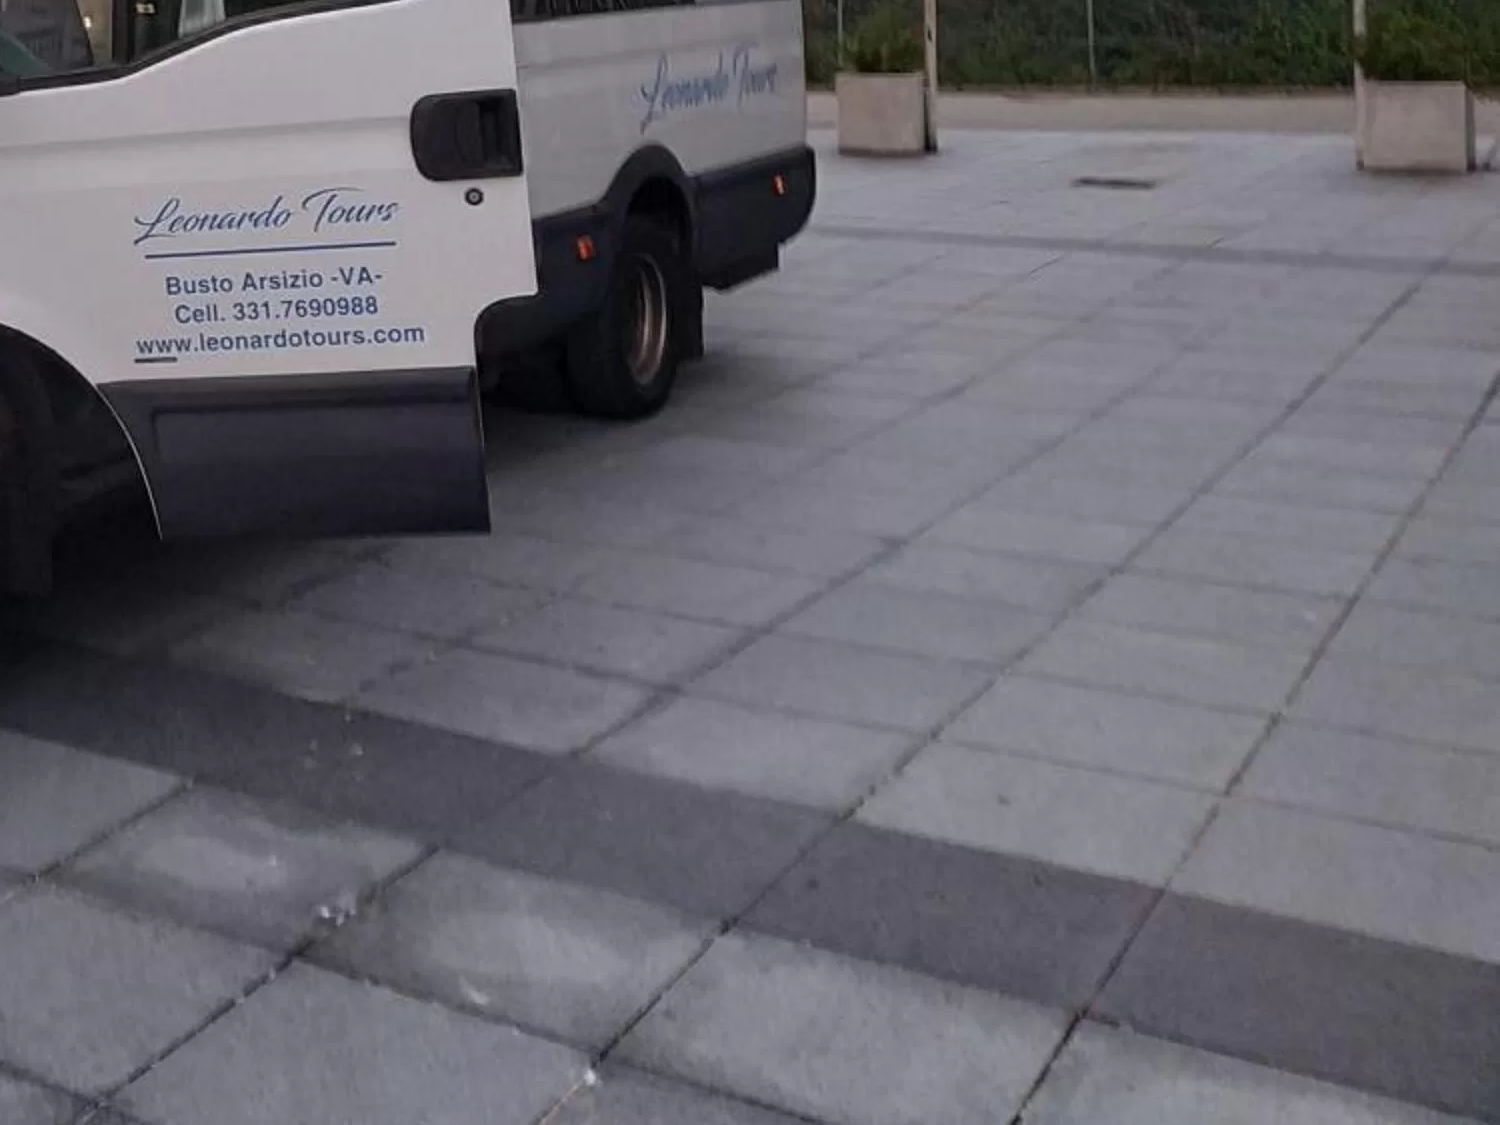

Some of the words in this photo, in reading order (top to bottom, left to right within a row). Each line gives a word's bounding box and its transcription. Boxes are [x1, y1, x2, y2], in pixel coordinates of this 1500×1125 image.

[133, 195, 292, 245] Leonardo
[301, 186, 398, 233] Tours
[165, 275, 233, 295] Busto
[241, 270, 324, 292] Arsizio
[330, 266, 383, 286] -VA-
[174, 303, 226, 324] Cell.
[232, 295, 379, 321] 331.7690988
[135, 327, 426, 353] www.leonardotours.com
